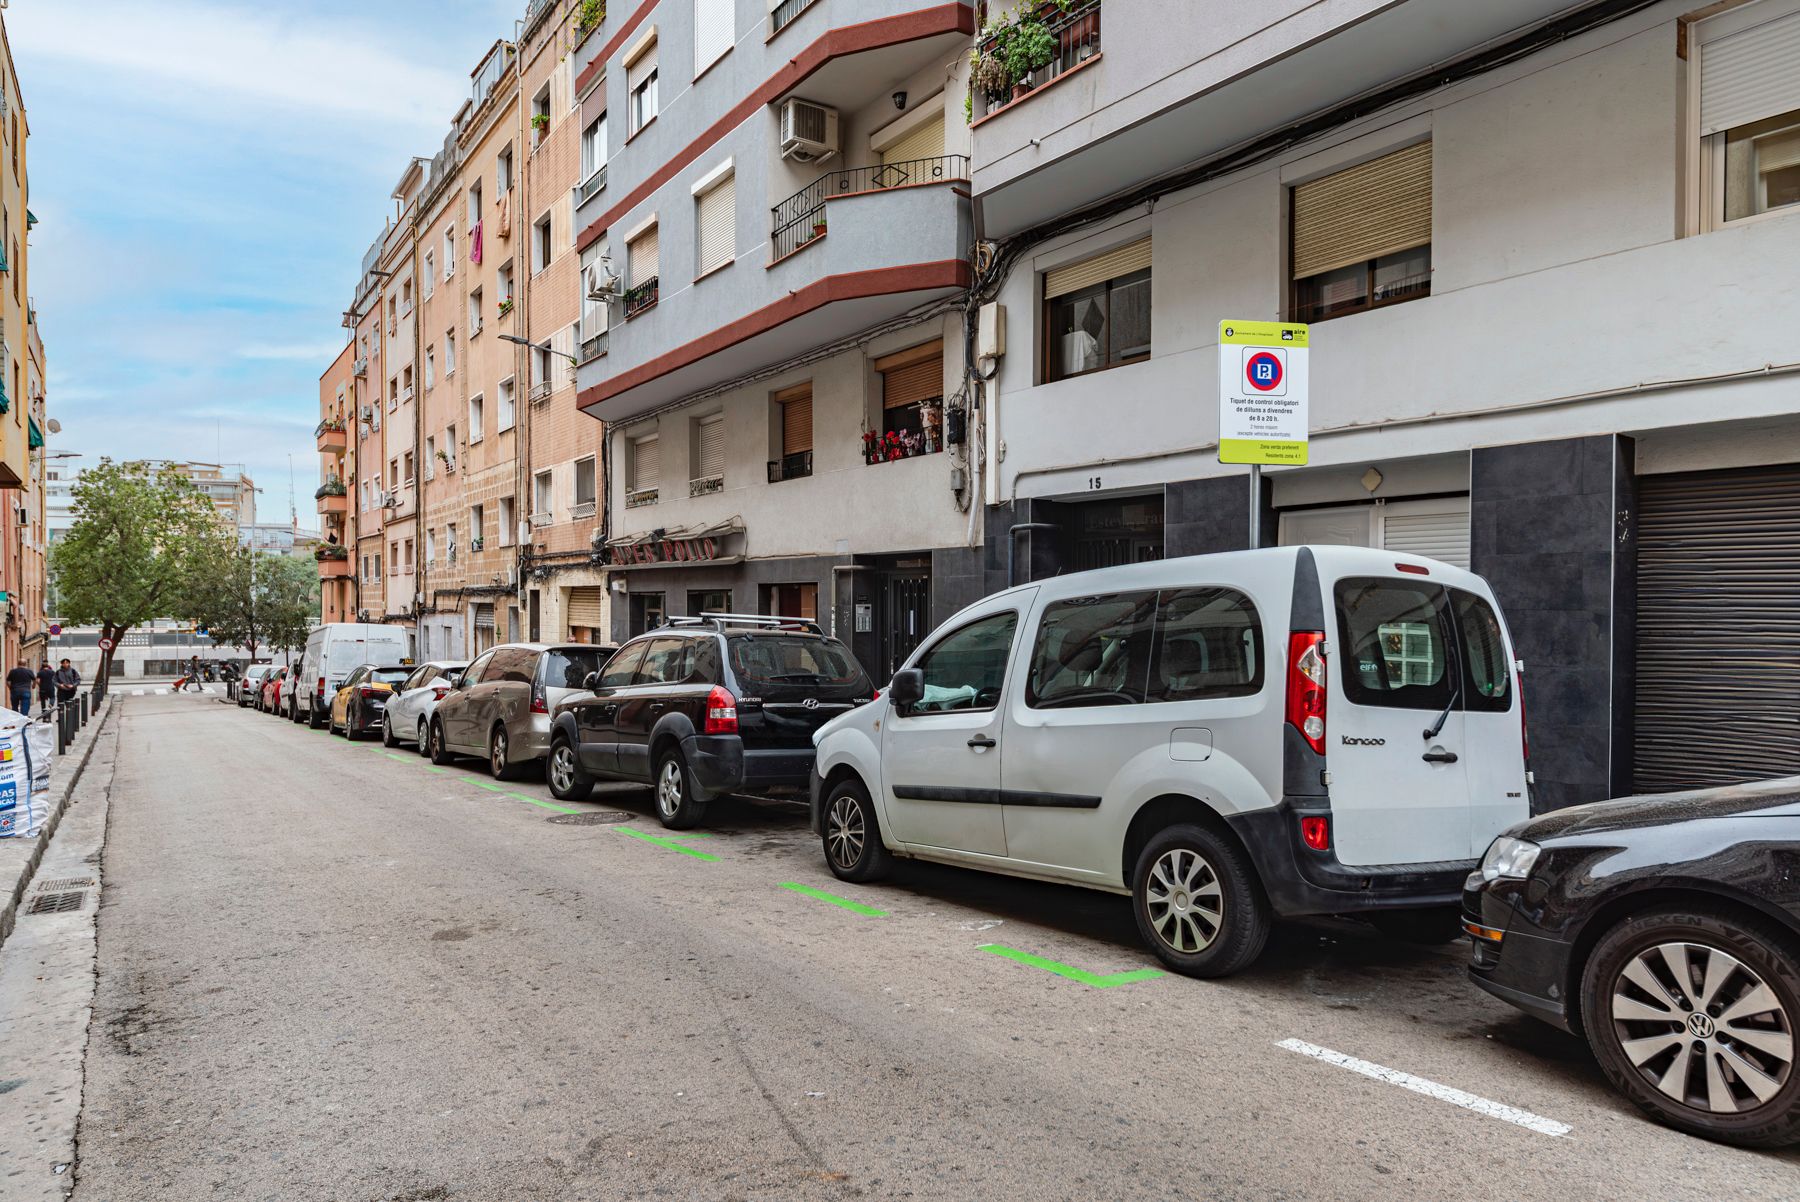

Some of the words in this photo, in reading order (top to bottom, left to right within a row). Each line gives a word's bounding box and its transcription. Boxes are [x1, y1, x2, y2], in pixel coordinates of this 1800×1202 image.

[1089, 477, 1101, 489] 15
[663, 538, 715, 562] POLLO
[1342, 735, 1385, 745] Kangoo
